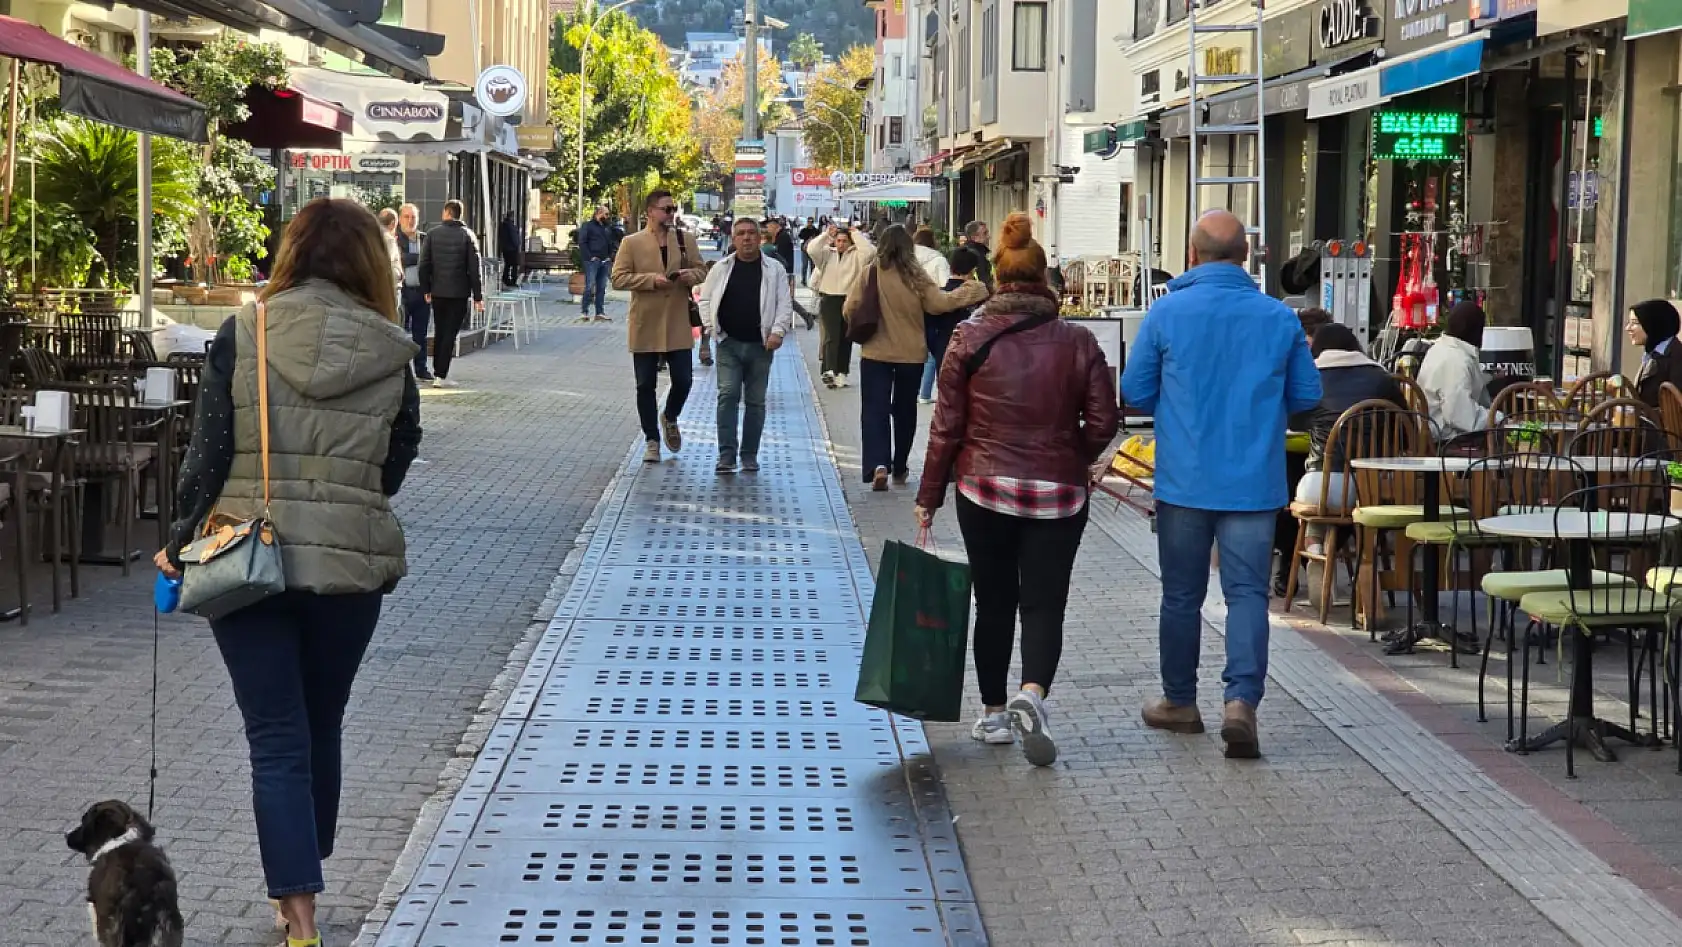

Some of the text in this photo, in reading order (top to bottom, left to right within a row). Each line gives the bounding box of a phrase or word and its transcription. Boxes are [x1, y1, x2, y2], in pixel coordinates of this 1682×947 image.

[370, 105, 439, 119] CINNABON
[1394, 137, 1443, 154] GSM
[311, 155, 352, 169] OPTIK
